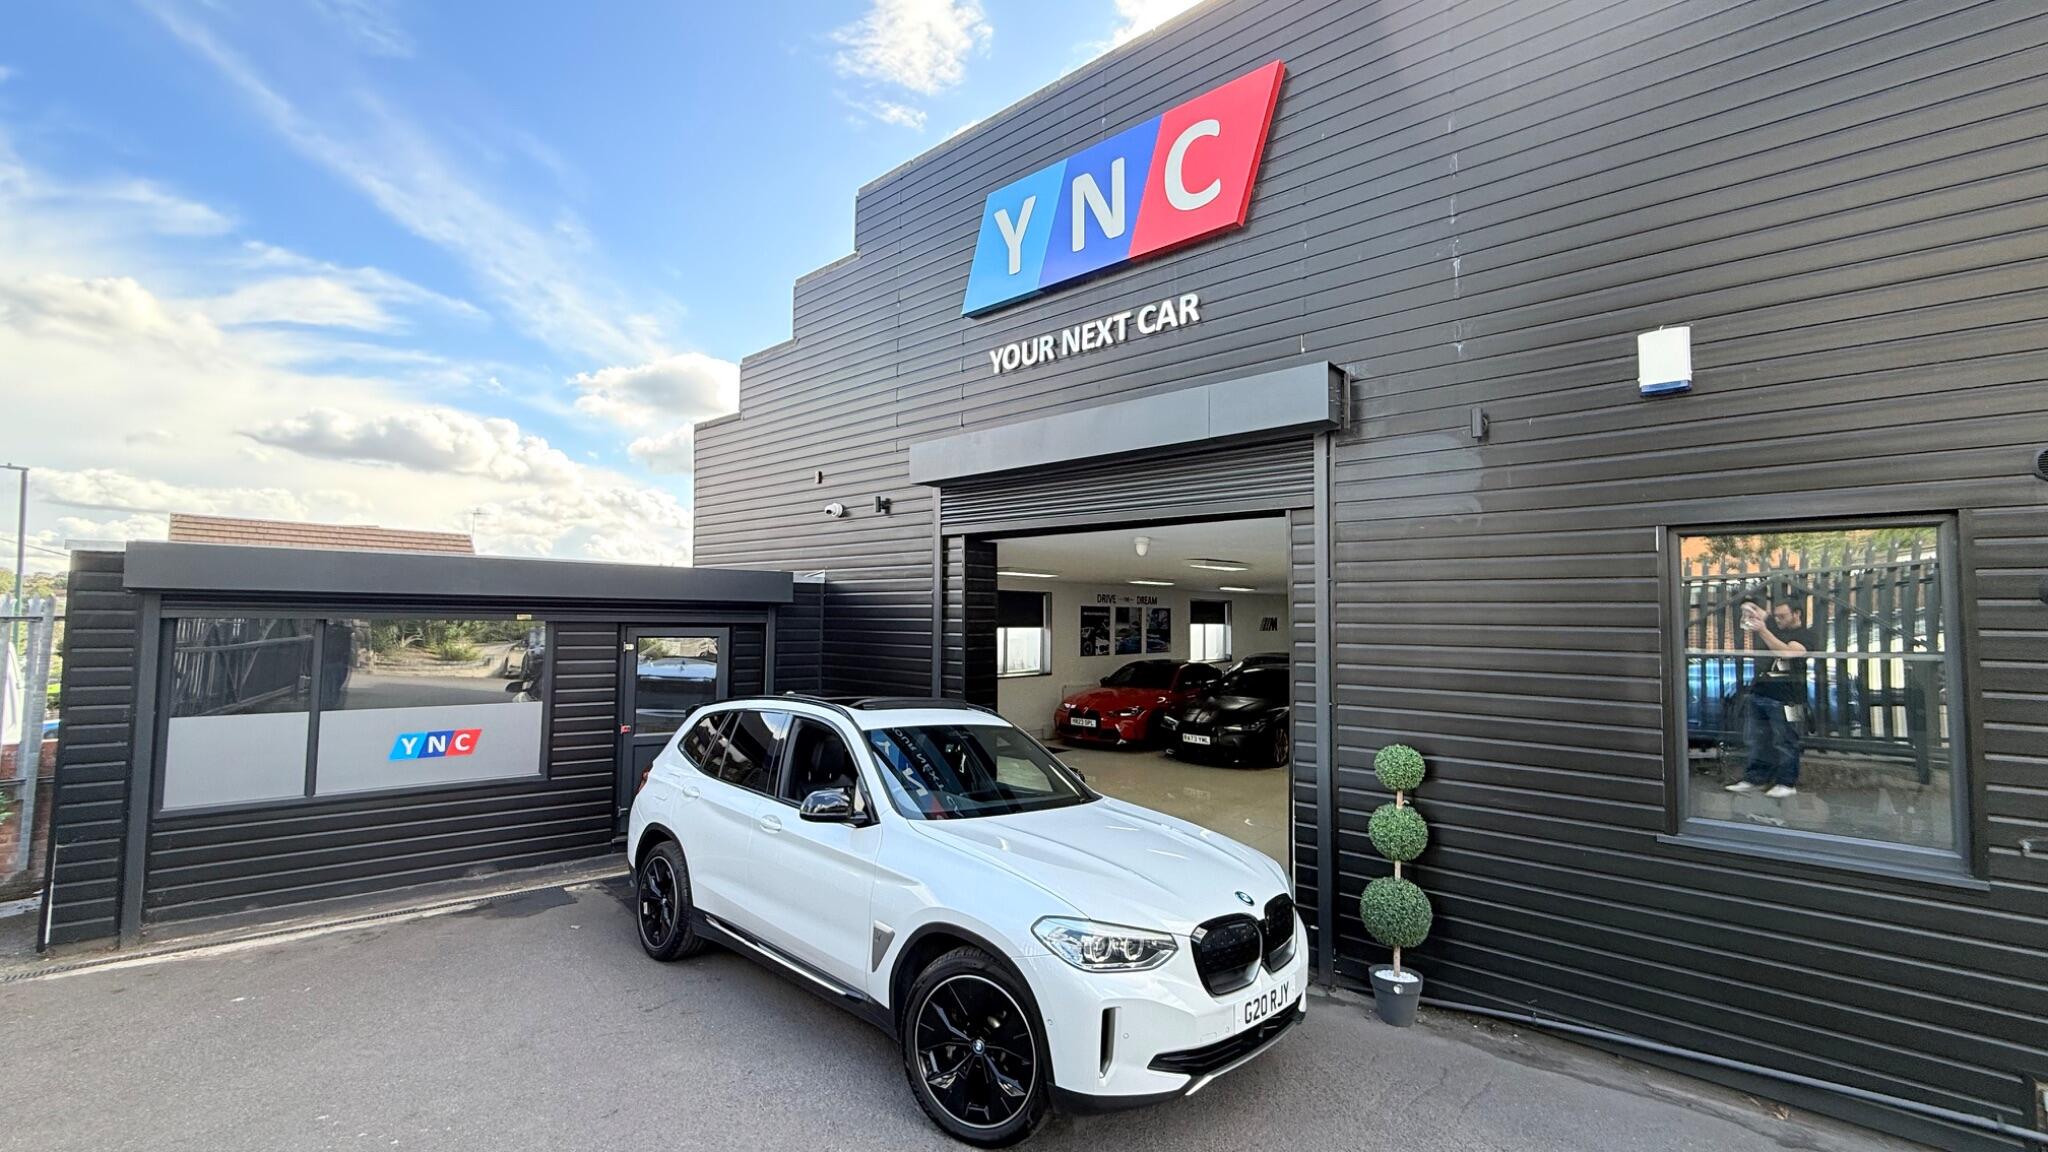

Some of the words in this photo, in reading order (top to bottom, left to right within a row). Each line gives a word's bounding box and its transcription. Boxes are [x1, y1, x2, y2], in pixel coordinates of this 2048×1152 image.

[994, 119, 1221, 275] YNC
[989, 336, 1055, 374] YOUR
[1061, 311, 1130, 356] NEXT
[1137, 293, 1199, 334] CAR
[1097, 594, 1116, 604] DRIVE
[1136, 596, 1158, 605] DREAM
[401, 734, 471, 755] YNC
[1245, 994, 1268, 1025] G20
[1270, 981, 1290, 1012] RJY
